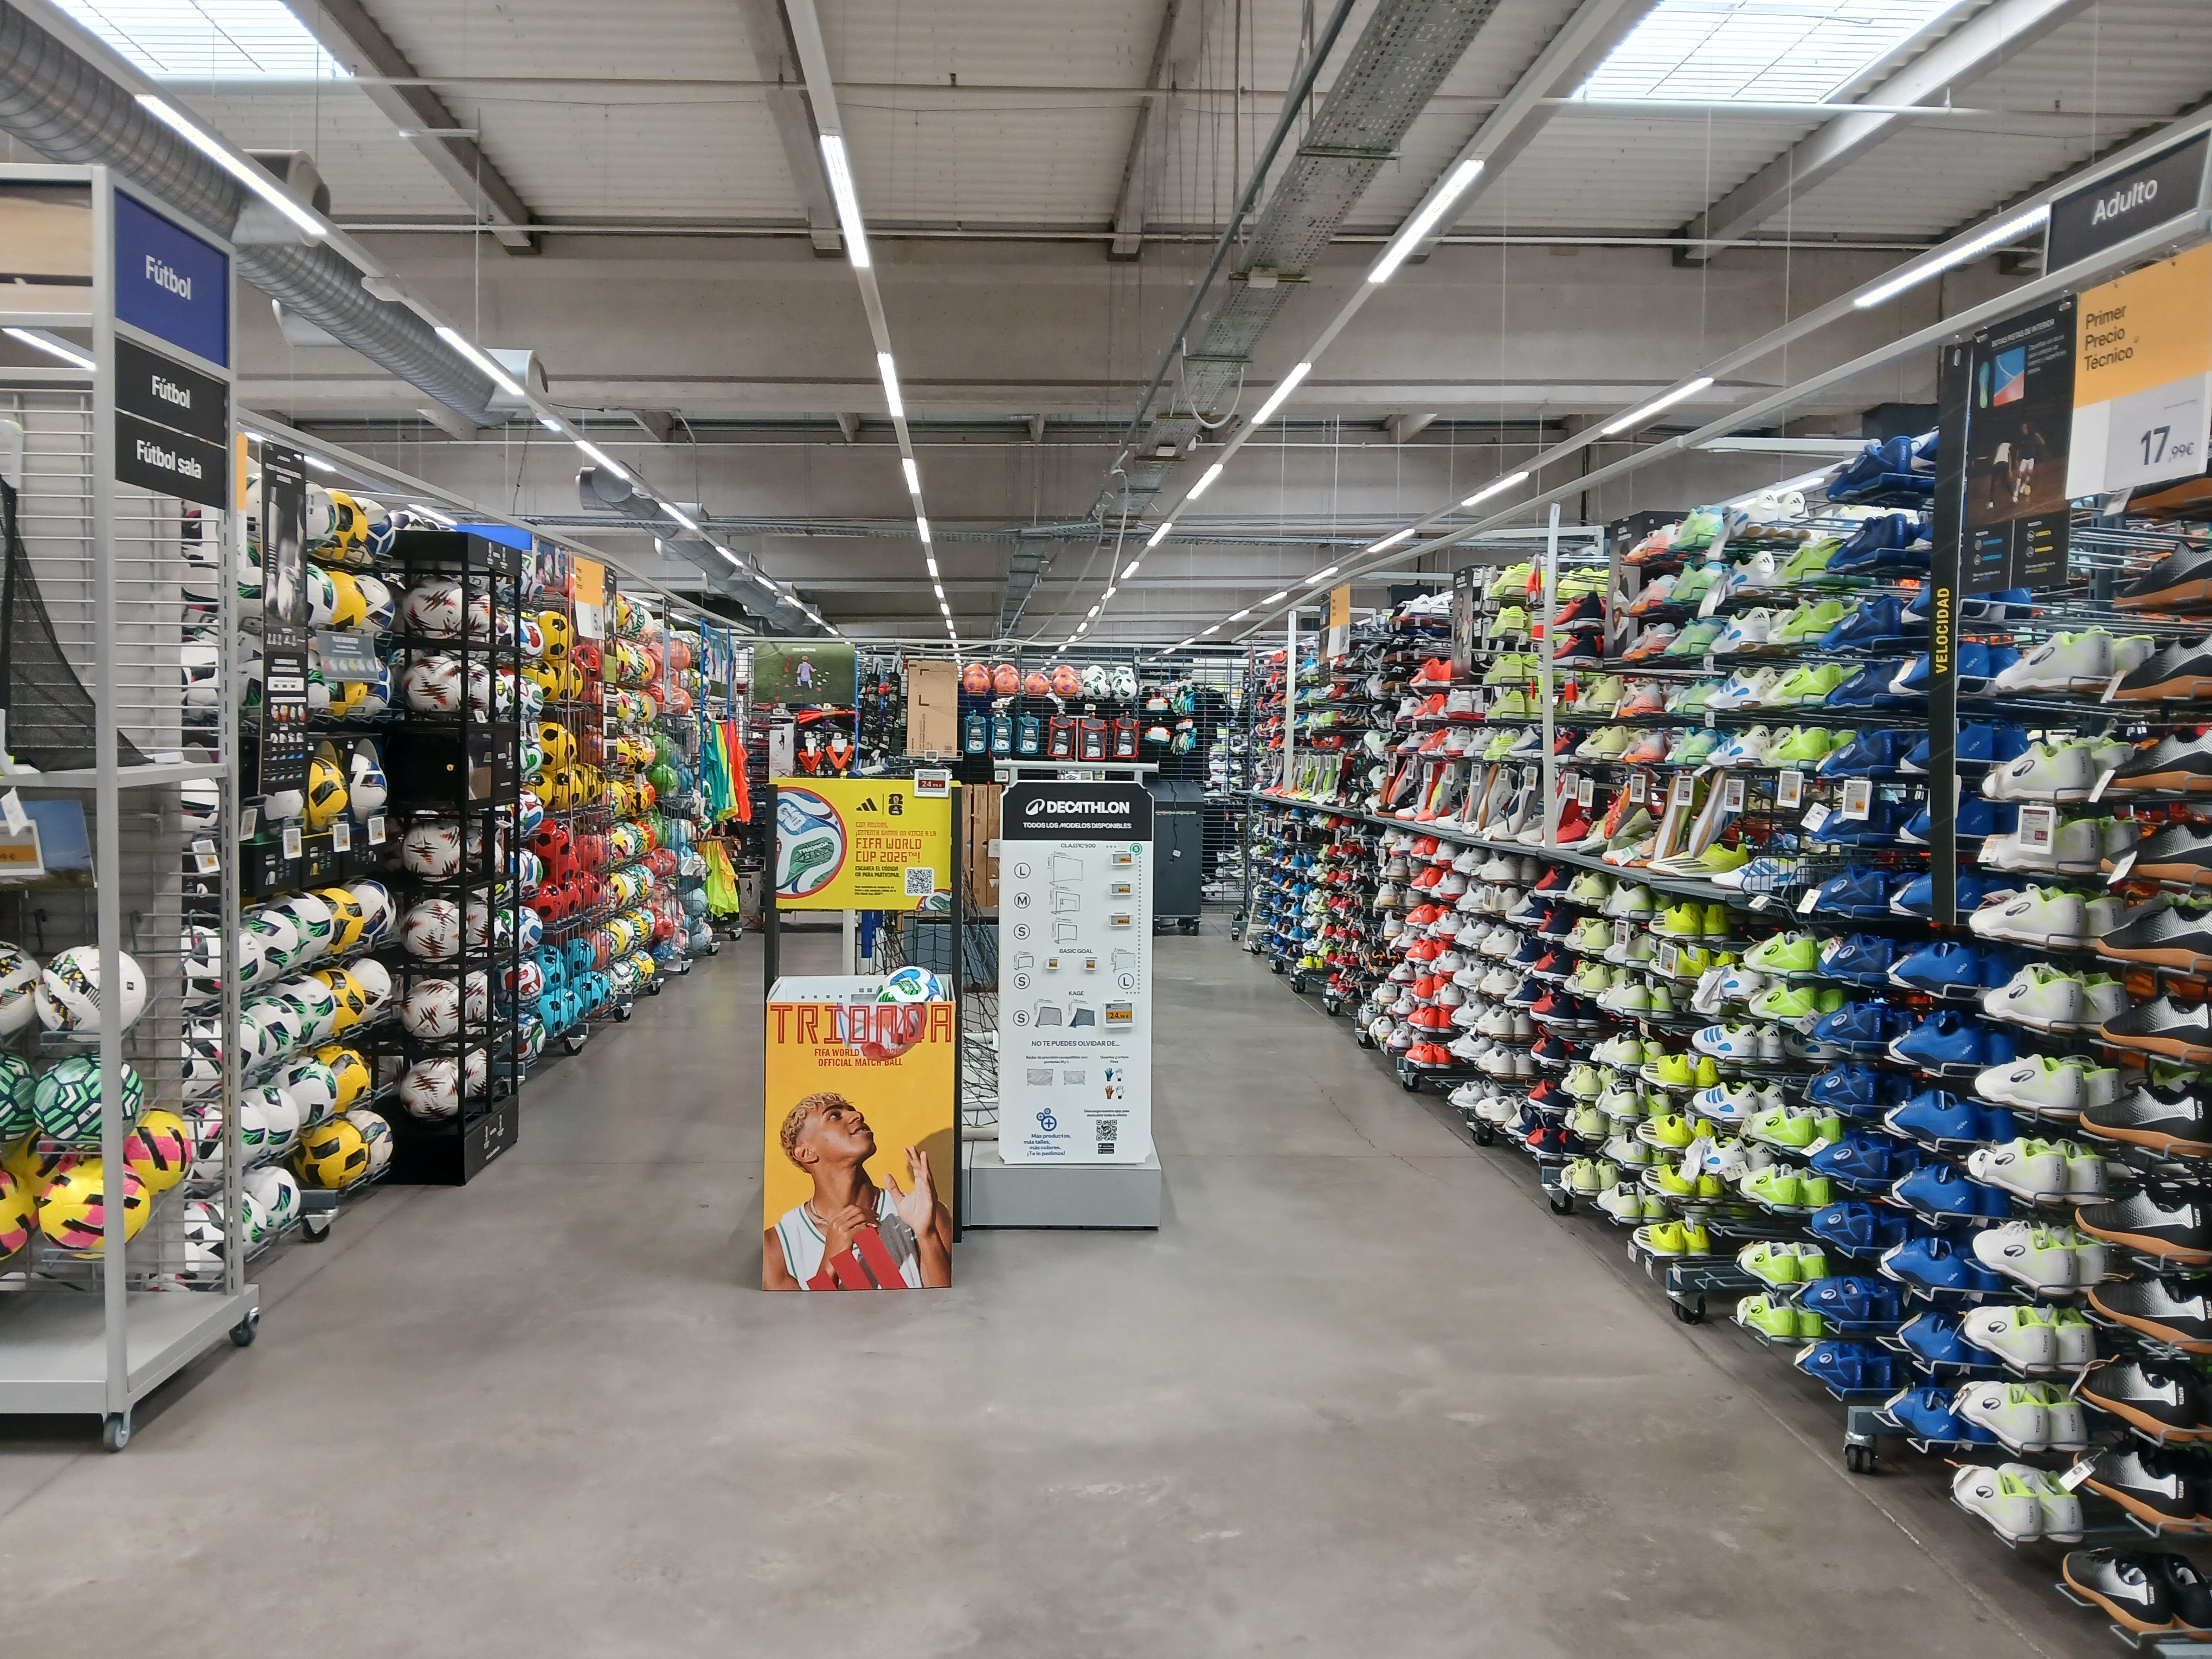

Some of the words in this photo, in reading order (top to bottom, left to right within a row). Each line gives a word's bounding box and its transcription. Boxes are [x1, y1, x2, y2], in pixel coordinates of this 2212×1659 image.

[2092, 179, 2157, 225] Adulto
[145, 254, 191, 300] Fútbol
[2085, 304, 2126, 330] Primer
[2085, 326, 2125, 351] Precio
[2084, 346, 2133, 371] Técnico
[151, 375, 190, 409] Fútbol
[136, 439, 176, 471] Fútbol
[178, 455, 202, 479] sala
[1935, 588, 1950, 674] VELOCIDAD
[1047, 801, 1130, 813] DECATHLON
[797, 842, 829, 854] TRIONDA
[856, 838, 882, 848] FIFA
[886, 838, 922, 850] WORLD
[856, 851, 876, 862] CUP
[1019, 866, 1026, 875] L
[1017, 896, 1027, 905] M
[1018, 927, 1026, 936] S
[1018, 976, 1026, 986] S
[1123, 977, 1129, 986] L
[770, 1005, 952, 1044] TRIONDA
[1018, 1014, 1025, 1023] S
[814, 1049, 830, 1057] FIFA
[832, 1049, 859, 1057] WORLD
[818, 1058, 852, 1066] OFFICIAL
[855, 1058, 881, 1066] MATCH
[884, 1058, 902, 1066] BALL
